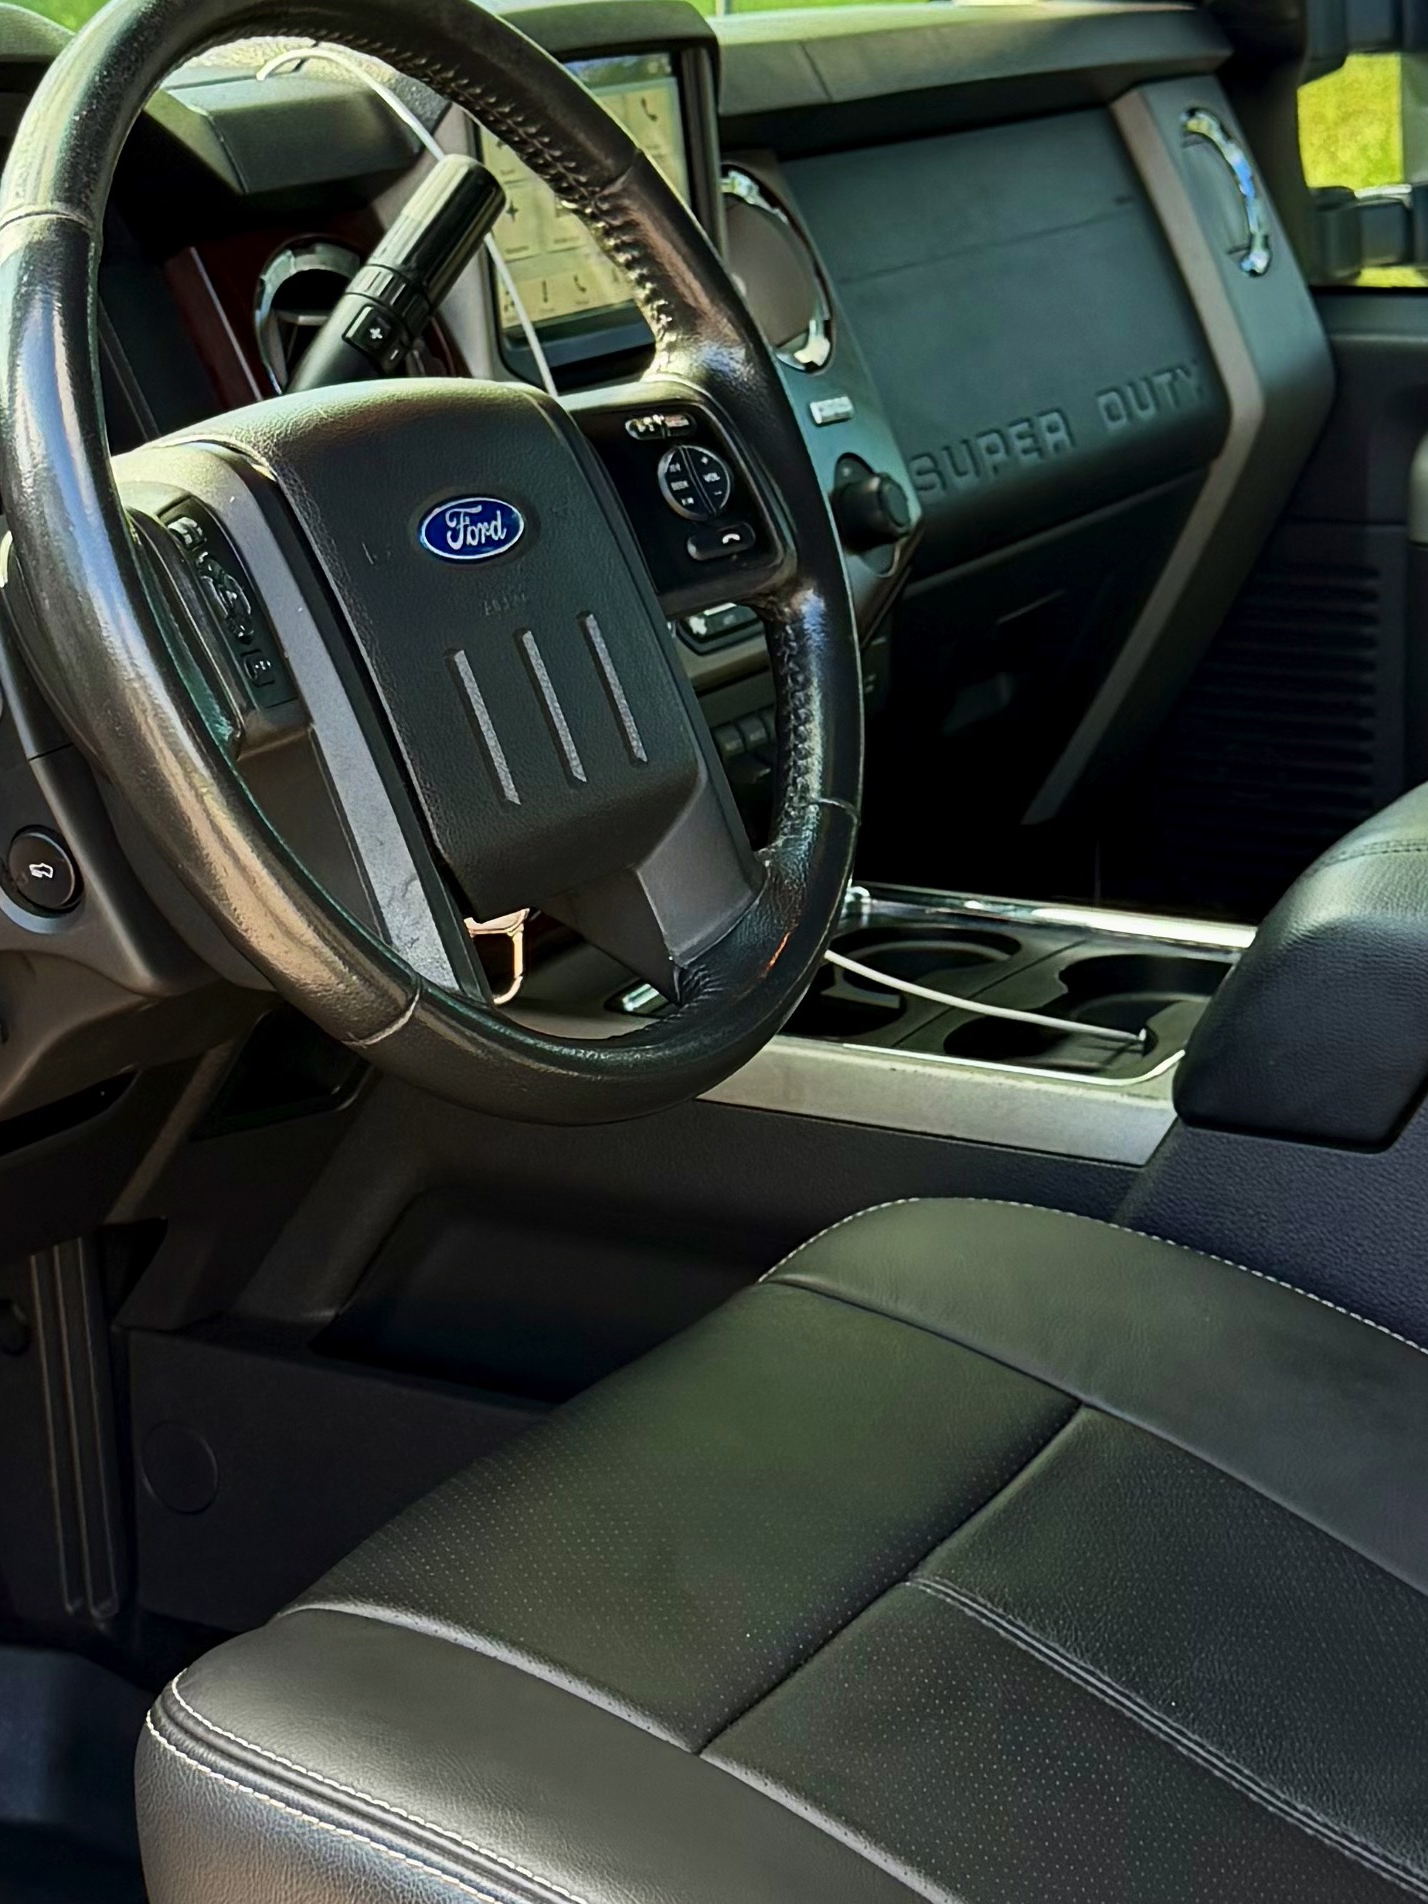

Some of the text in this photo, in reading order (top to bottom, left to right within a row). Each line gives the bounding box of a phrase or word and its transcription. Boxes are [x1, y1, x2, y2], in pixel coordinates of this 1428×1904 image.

[909, 360, 1203, 496] SUPER DUTY
[445, 505, 507, 550] Ford
